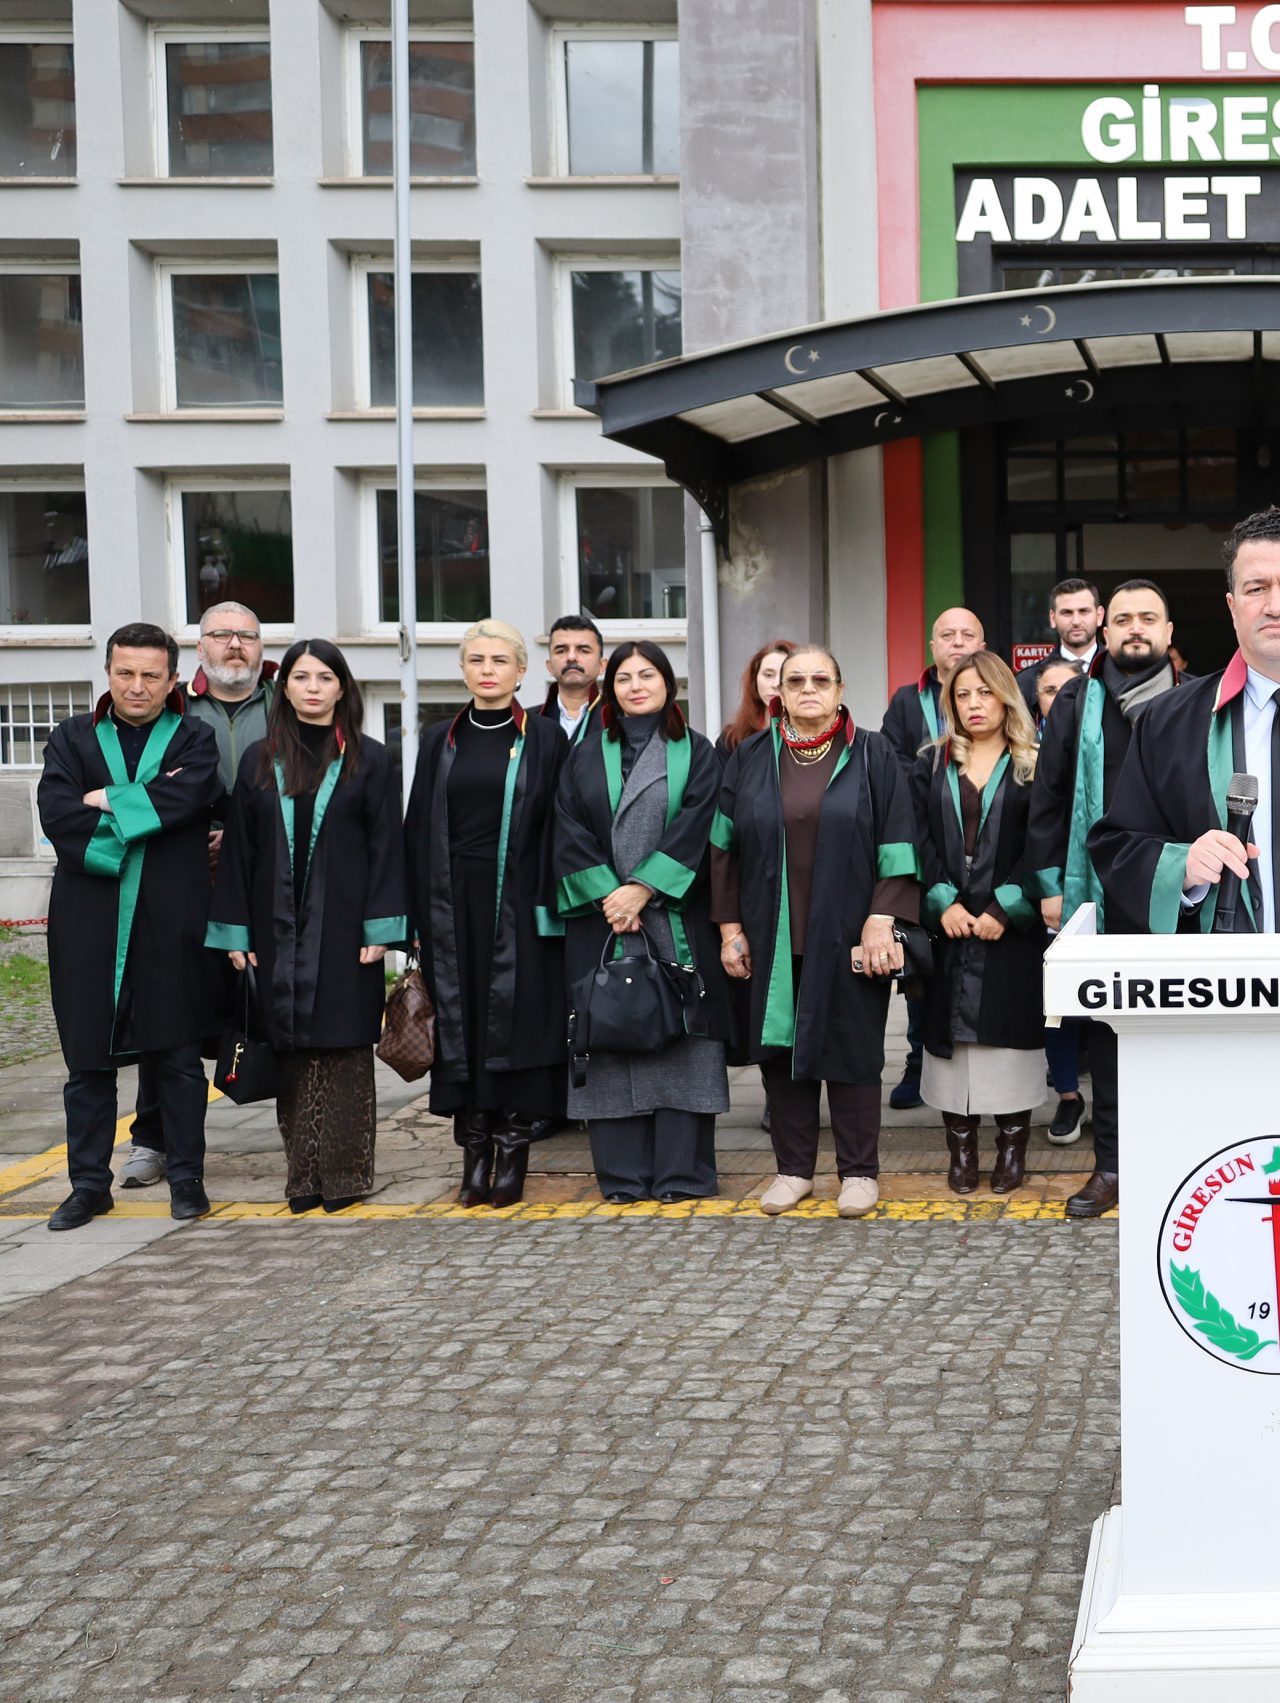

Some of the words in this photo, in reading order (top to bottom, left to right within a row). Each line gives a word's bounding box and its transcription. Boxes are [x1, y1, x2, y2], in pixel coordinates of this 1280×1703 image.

[955, 175, 1262, 242] ADALET
[1077, 971, 1280, 1010] GİRESUN
[1172, 1152, 1256, 1252] GİRESUN
[1247, 1301, 1271, 1320] 19
